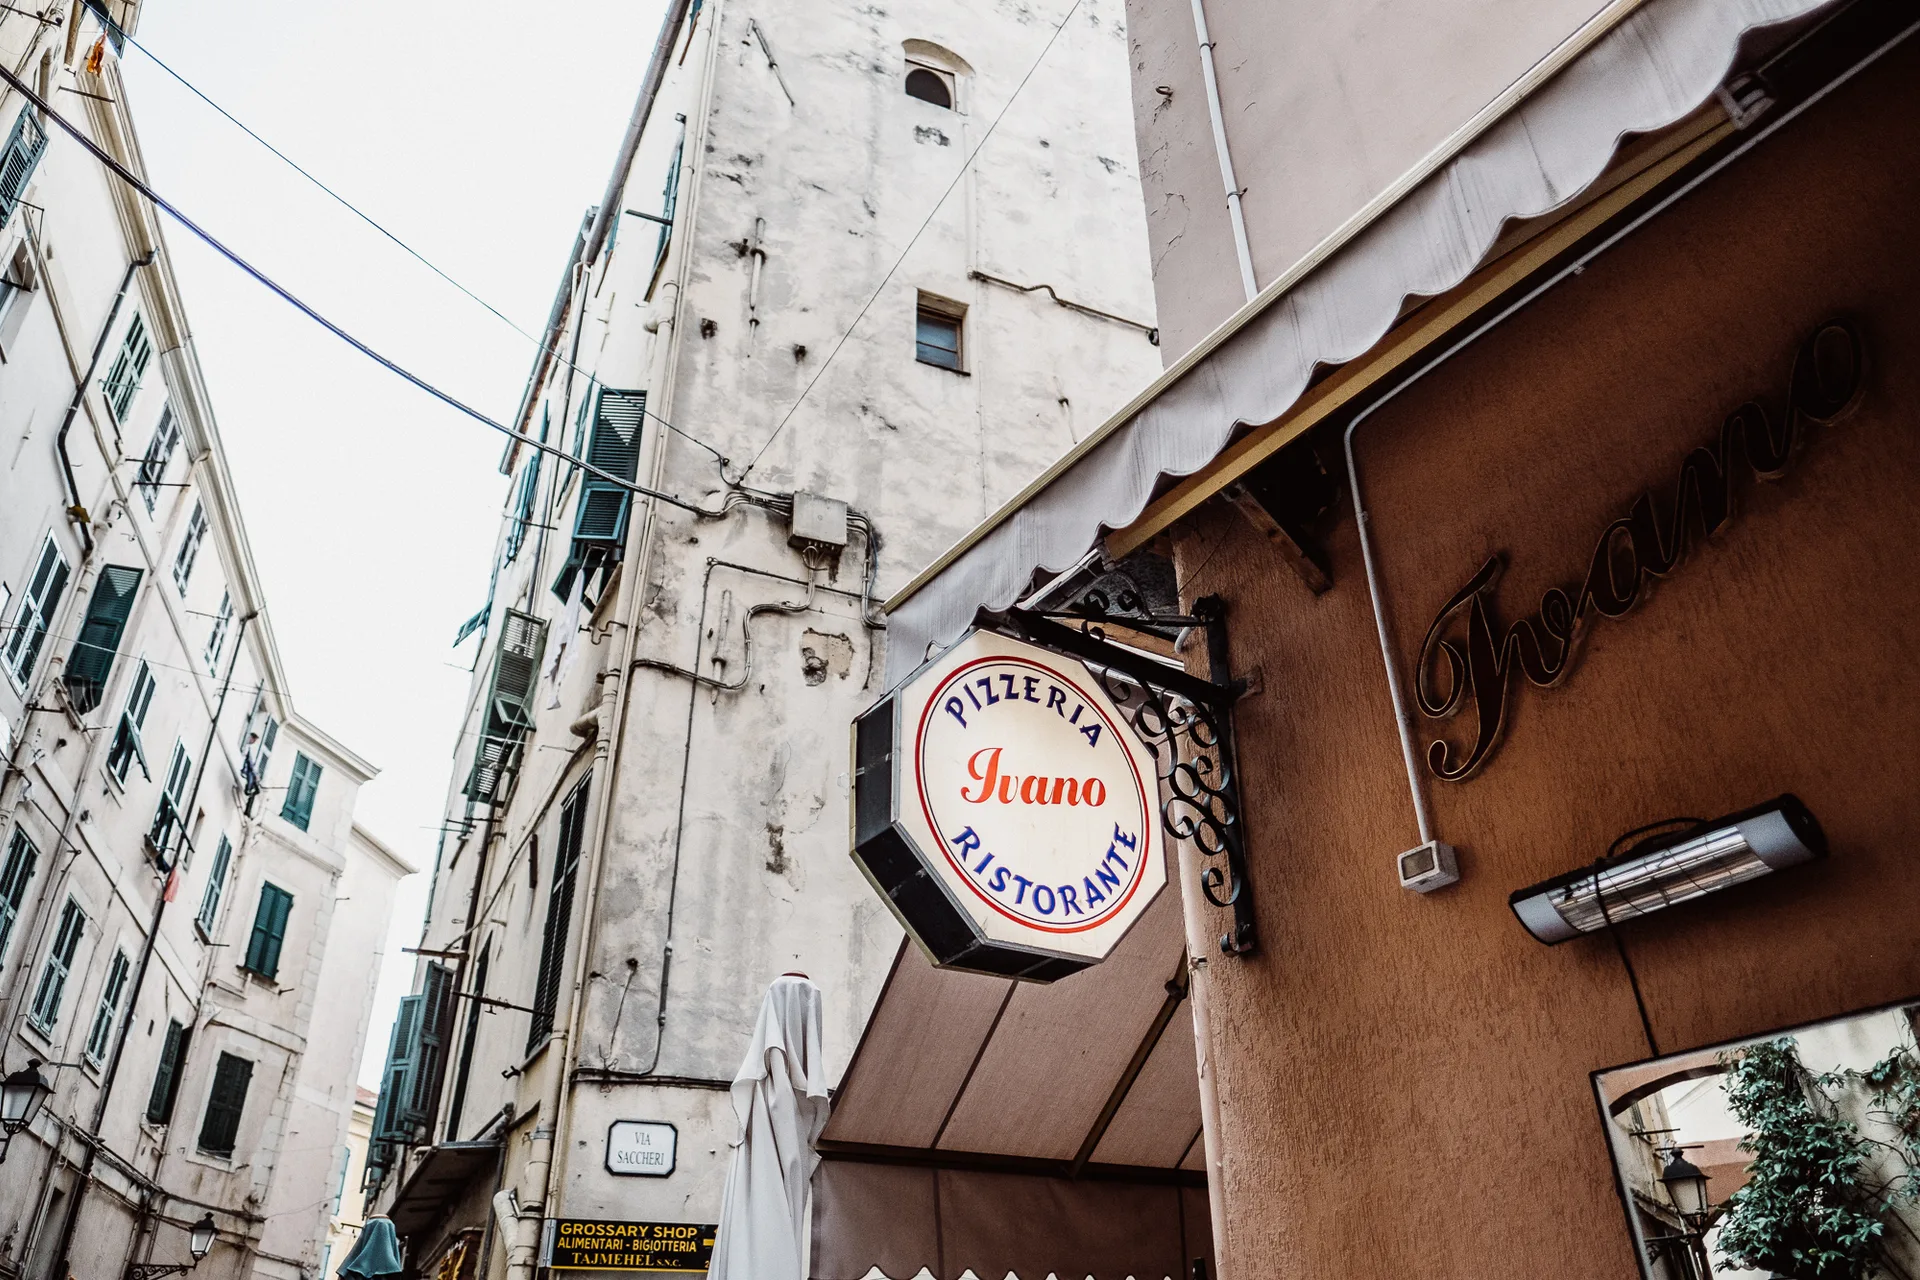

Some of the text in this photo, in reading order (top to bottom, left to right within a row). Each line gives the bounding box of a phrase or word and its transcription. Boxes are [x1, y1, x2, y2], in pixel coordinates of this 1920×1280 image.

[1415, 316, 1866, 782] Ivano
[944, 673, 1104, 748] PIZZERIA
[960, 747, 1107, 807] Ivano
[951, 822, 1138, 917] RISTORANTE
[634, 1131, 651, 1146] VIA
[616, 1150, 665, 1166] SACCHERI
[560, 1222, 698, 1239] GROSSARY SHOP
[557, 1236, 624, 1250] ALIMENTARI
[632, 1239, 697, 1253] BIGIOTTERIA
[571, 1252, 655, 1266] TAJMEHEL
